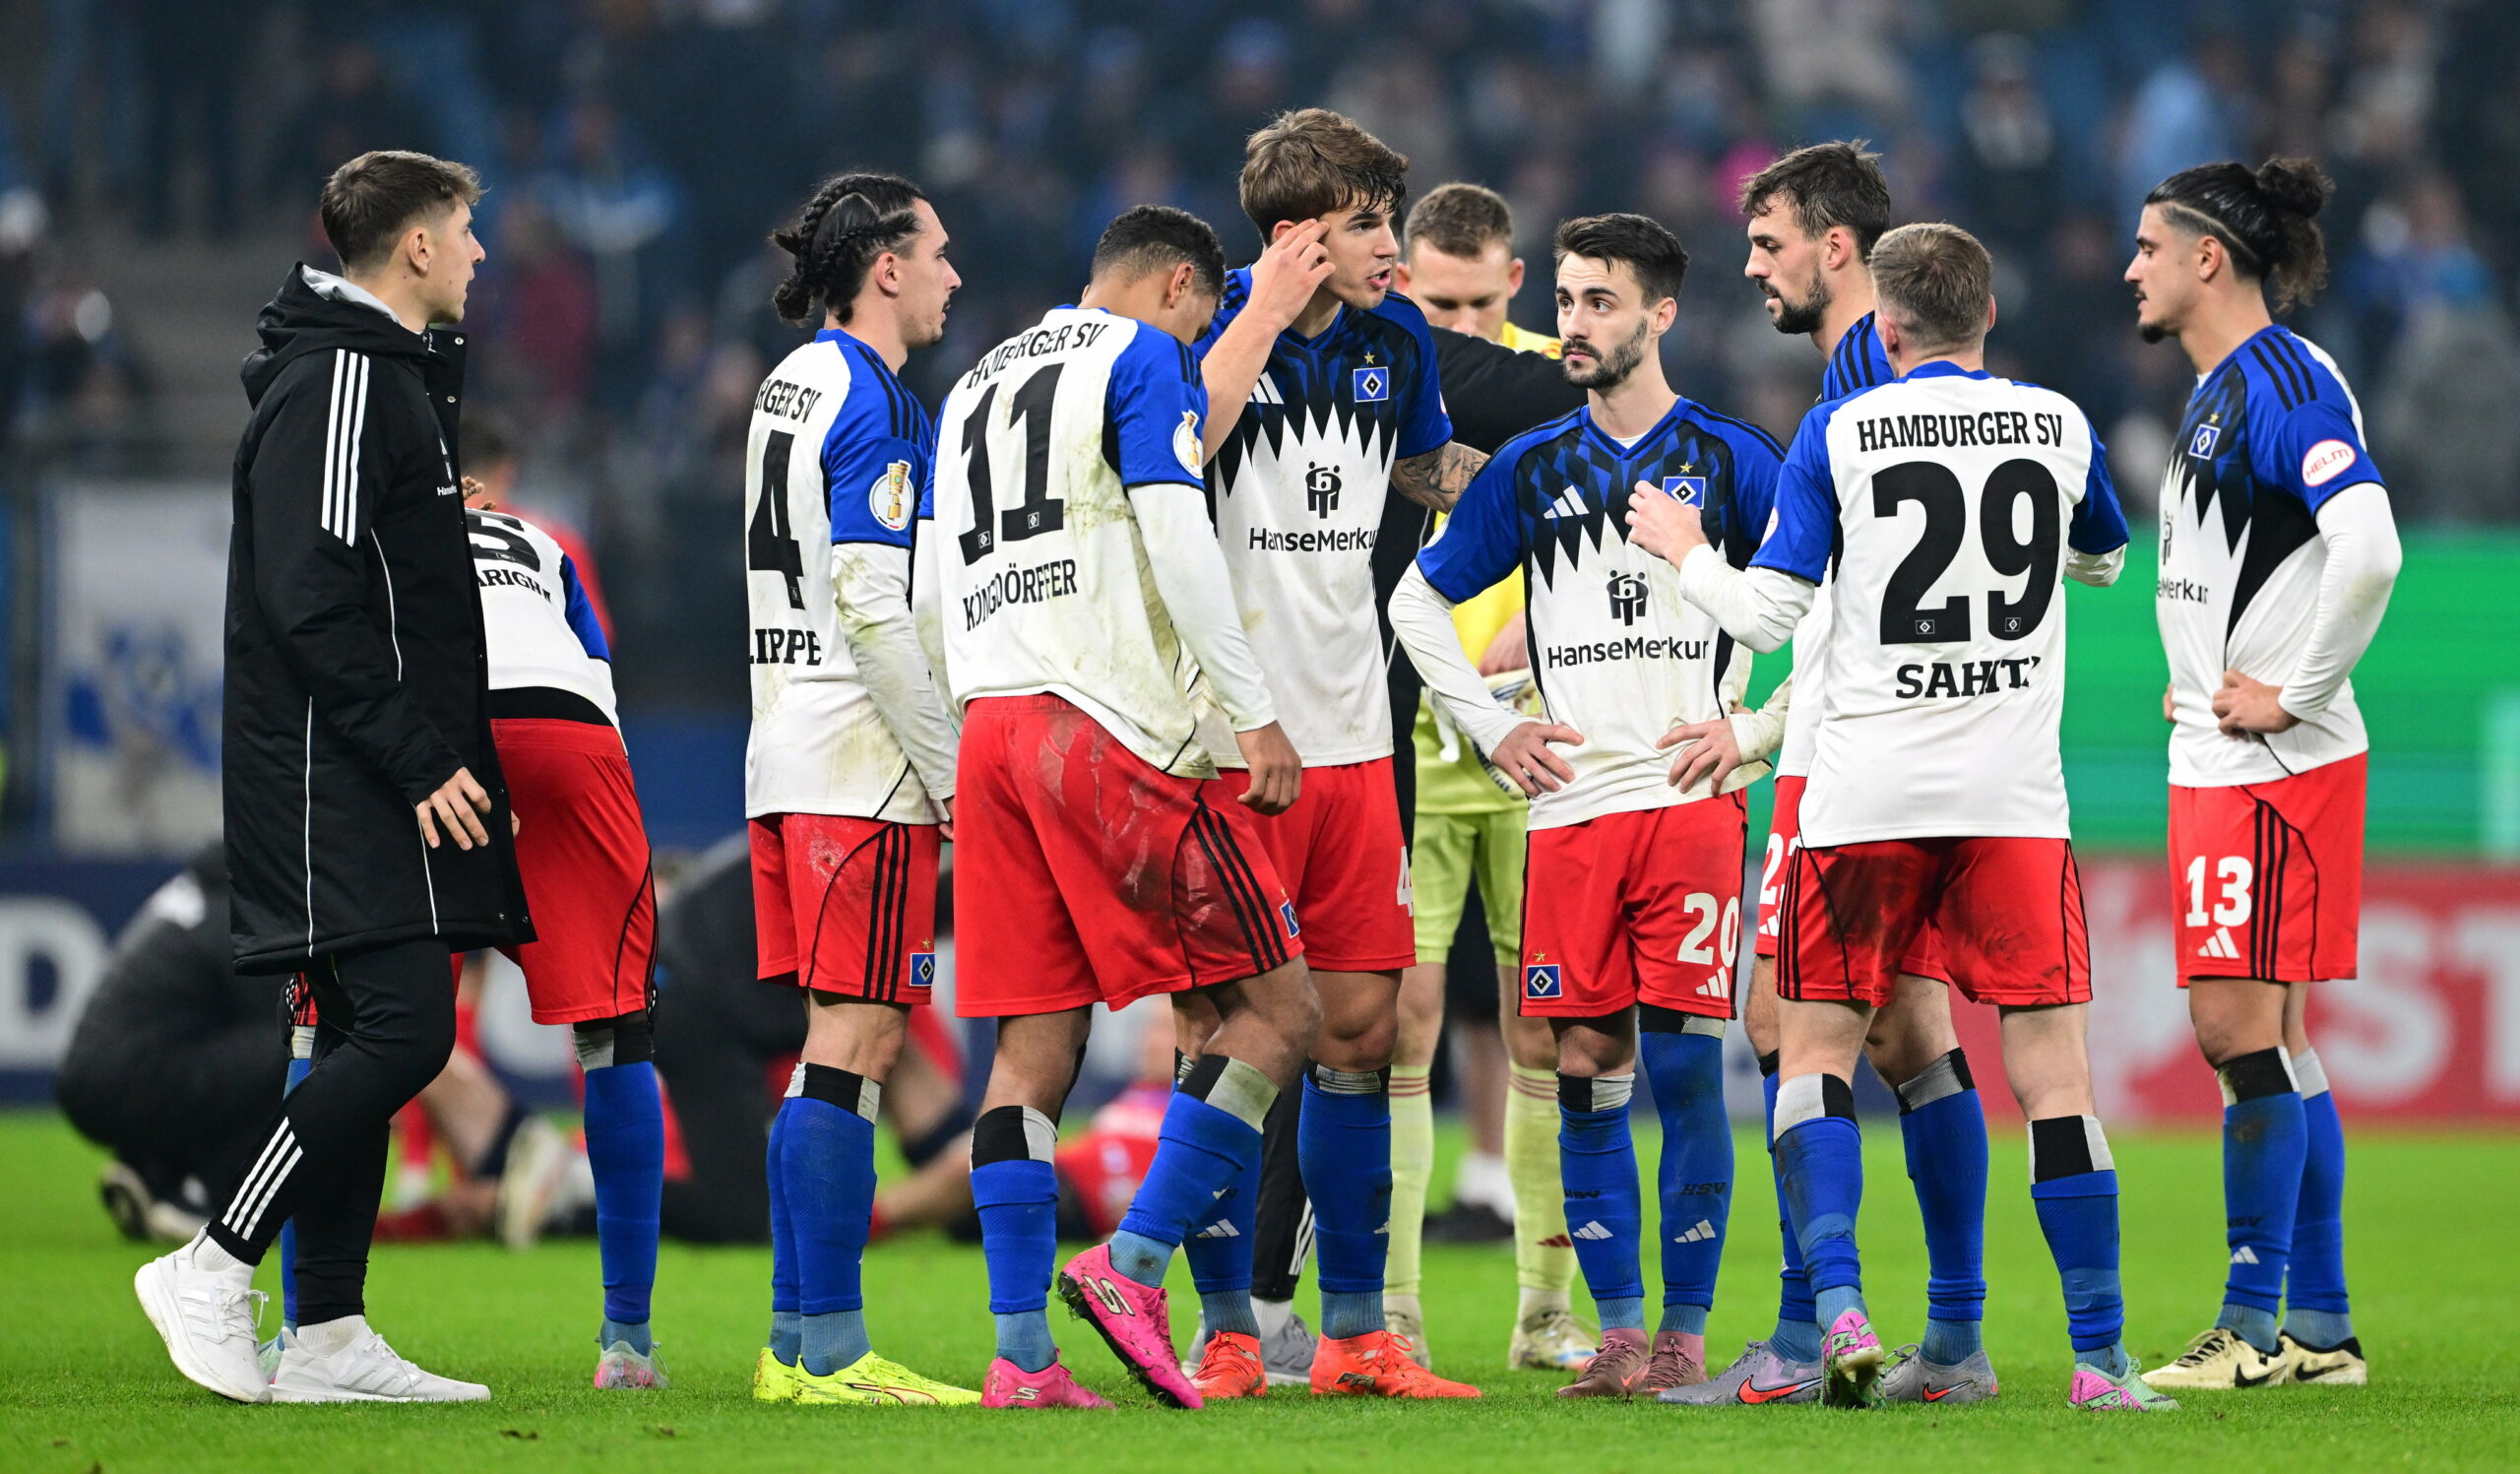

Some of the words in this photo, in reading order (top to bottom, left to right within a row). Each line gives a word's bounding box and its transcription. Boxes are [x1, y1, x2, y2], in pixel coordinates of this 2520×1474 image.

[1071, 322, 1108, 350] SV
[790, 387, 822, 423] SV
[1857, 412, 2031, 452] HAMBURGER
[2035, 412, 2062, 448] SV
[957, 362, 1065, 566] 11
[748, 429, 805, 610] 4
[1871, 458, 2060, 645] 29
[749, 628, 822, 667] IPPE
[1547, 636, 1709, 669] HanseMerkur
[2185, 856, 2253, 928] 13
[1677, 892, 1739, 968] 20
[1679, 1181, 1727, 1196] HSV
